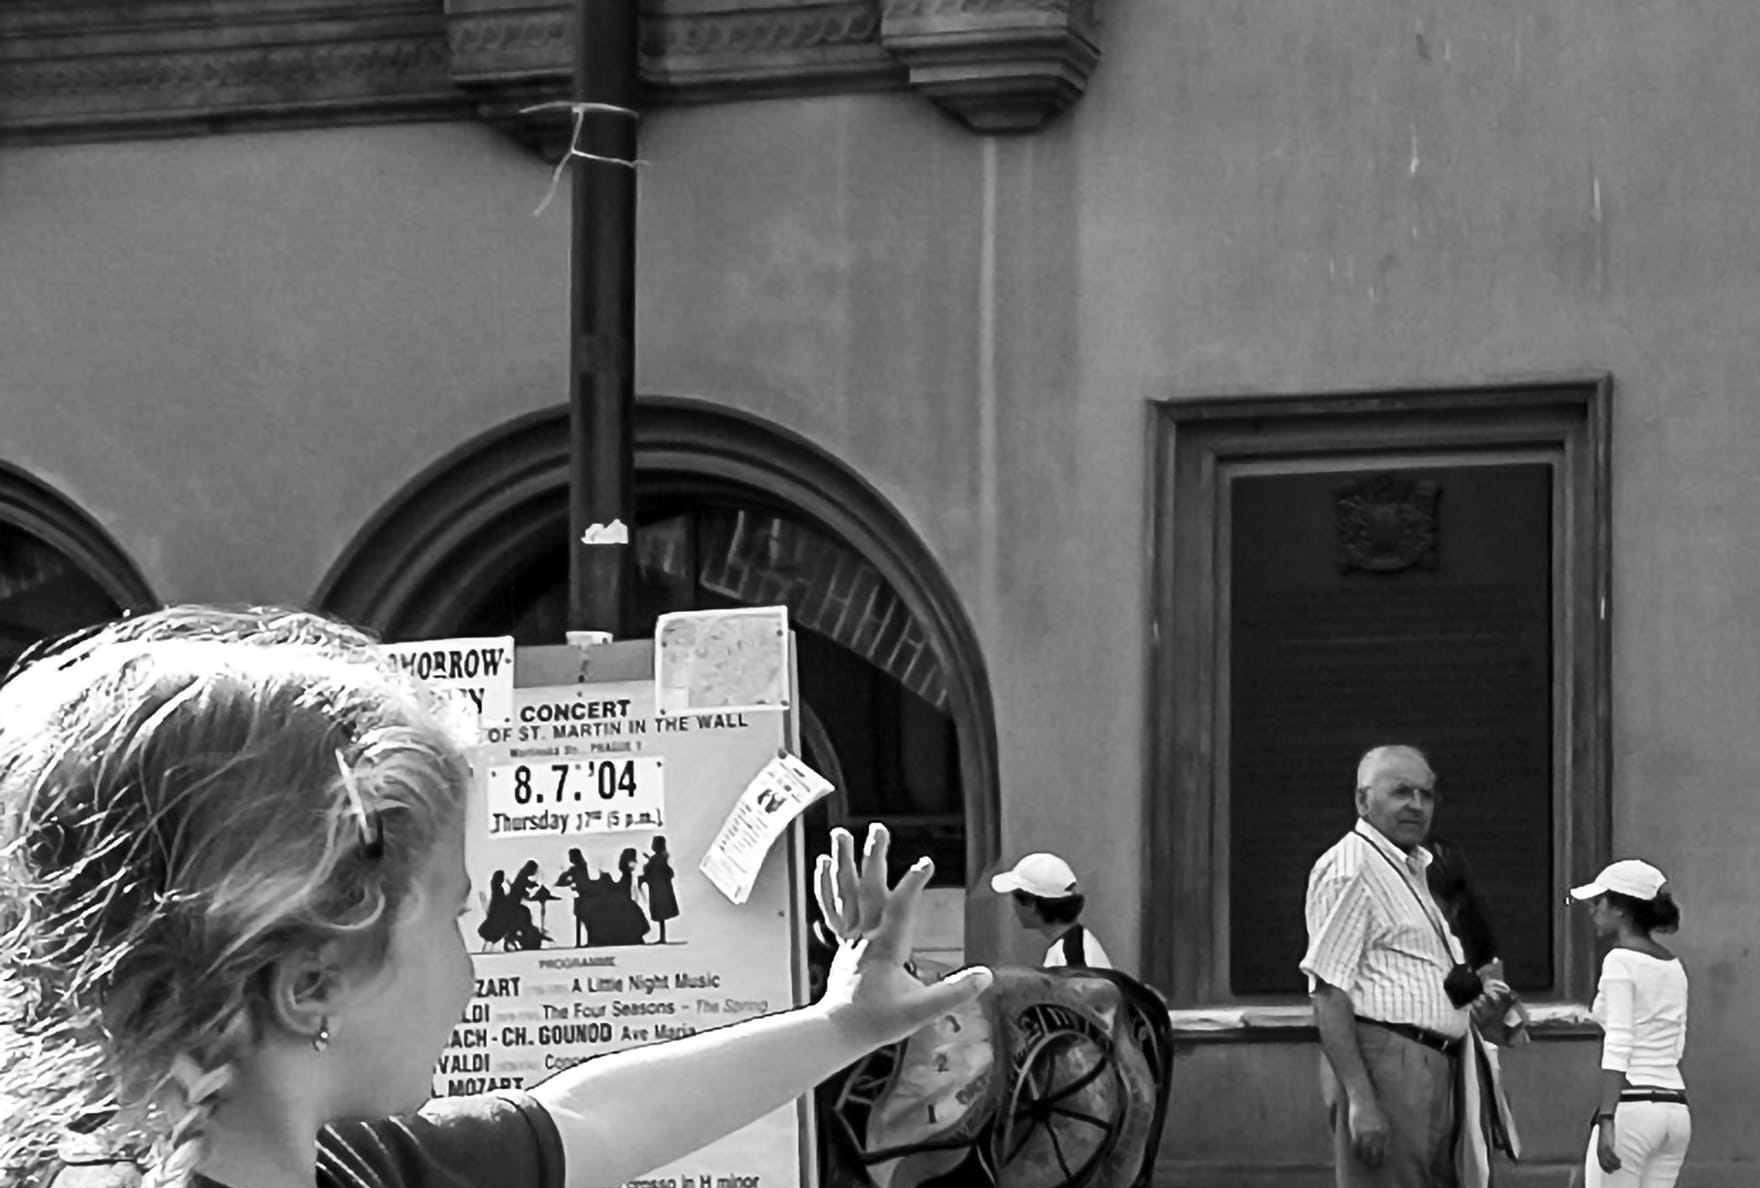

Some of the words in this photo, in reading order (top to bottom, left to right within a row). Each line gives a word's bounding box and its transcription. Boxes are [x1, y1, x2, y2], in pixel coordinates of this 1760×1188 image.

[386, 648, 505, 681] OMORROW
[520, 699, 631, 723] CONCERT
[488, 727, 513, 743] OF
[518, 725, 547, 742] ST.
[553, 721, 621, 739] MARTIN
[629, 719, 646, 734] IN
[655, 716, 689, 733] THE
[697, 713, 749, 729] WALL
[490, 809, 569, 834] Thursday
[475, 976, 521, 998] ZART
[571, 978, 582, 993] A
[629, 974, 669, 995] Night
[675, 972, 721, 989] Music
[542, 1004, 568, 1020] The
[574, 1002, 606, 1018] Four
[612, 1000, 675, 1018] Seasons
[450, 1028, 488, 1049] ACH
[502, 1026, 535, 1047] CH.
[538, 1023, 613, 1046] GOUNOD
[621, 1026, 649, 1042] Ave
[434, 1053, 490, 1074] VALDI
